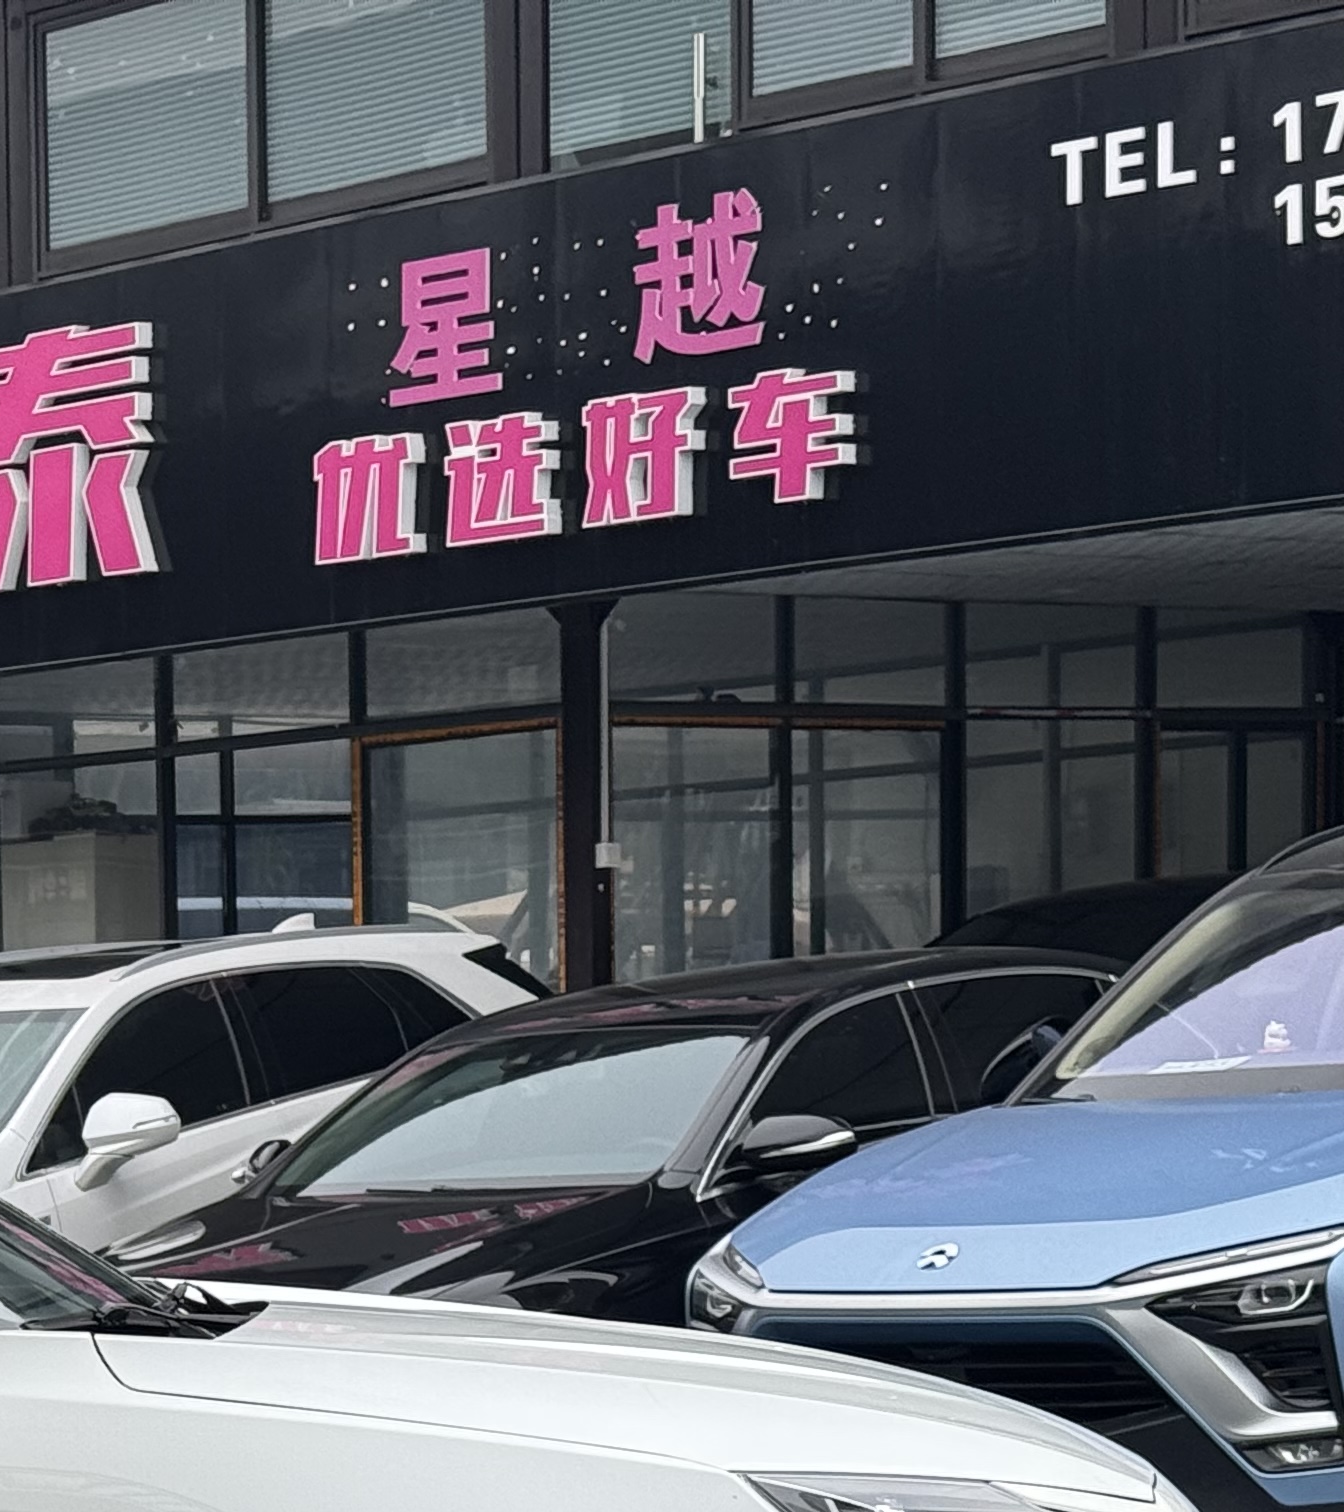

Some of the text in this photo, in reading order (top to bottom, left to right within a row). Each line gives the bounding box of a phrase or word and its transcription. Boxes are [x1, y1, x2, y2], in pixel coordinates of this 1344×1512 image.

[1050, 121, 1236, 206] TEL:
[389, 187, 766, 408] 星越
[312, 368, 857, 567] 优选好车
